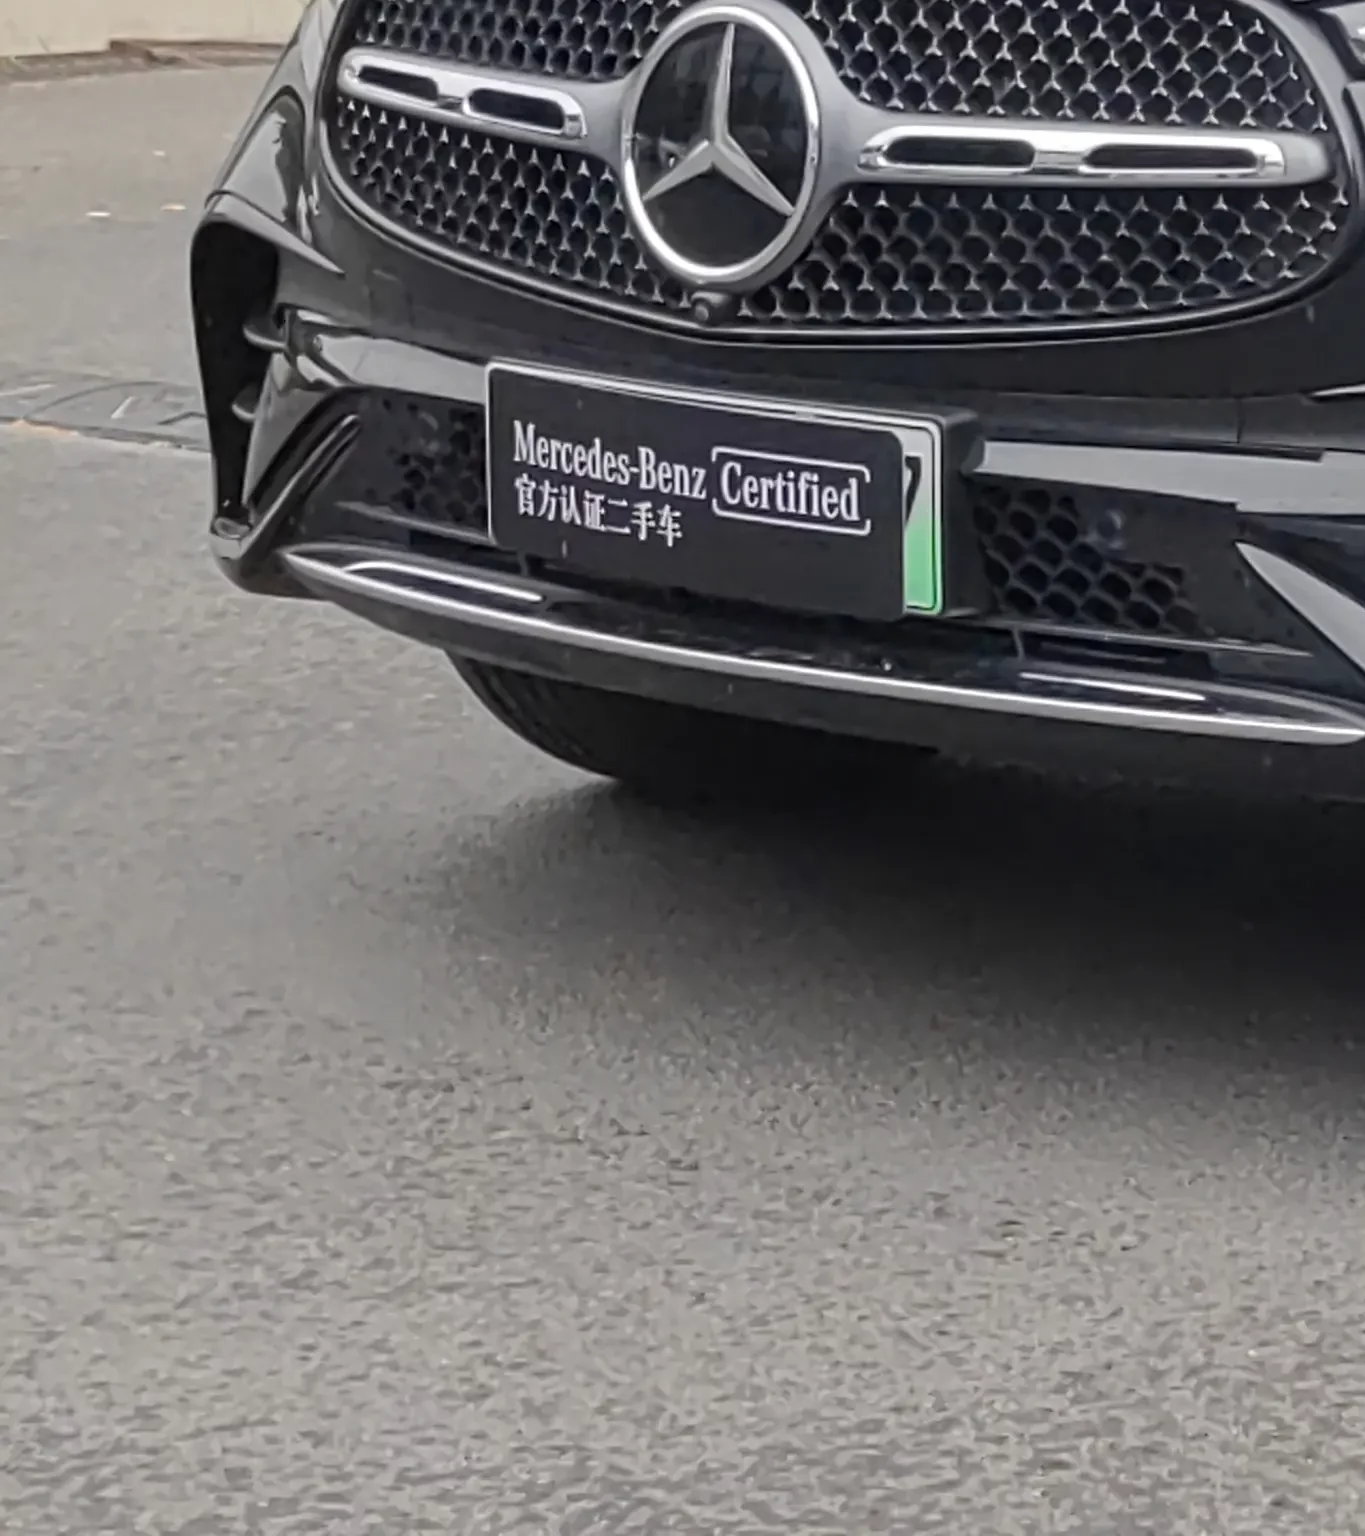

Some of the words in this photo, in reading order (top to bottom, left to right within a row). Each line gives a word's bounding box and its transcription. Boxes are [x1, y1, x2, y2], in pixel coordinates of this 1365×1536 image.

[513, 420, 706, 499] Mercedes-Benz
[720, 461, 860, 521] Certified
[514, 473, 683, 547] 官方认证二手车
